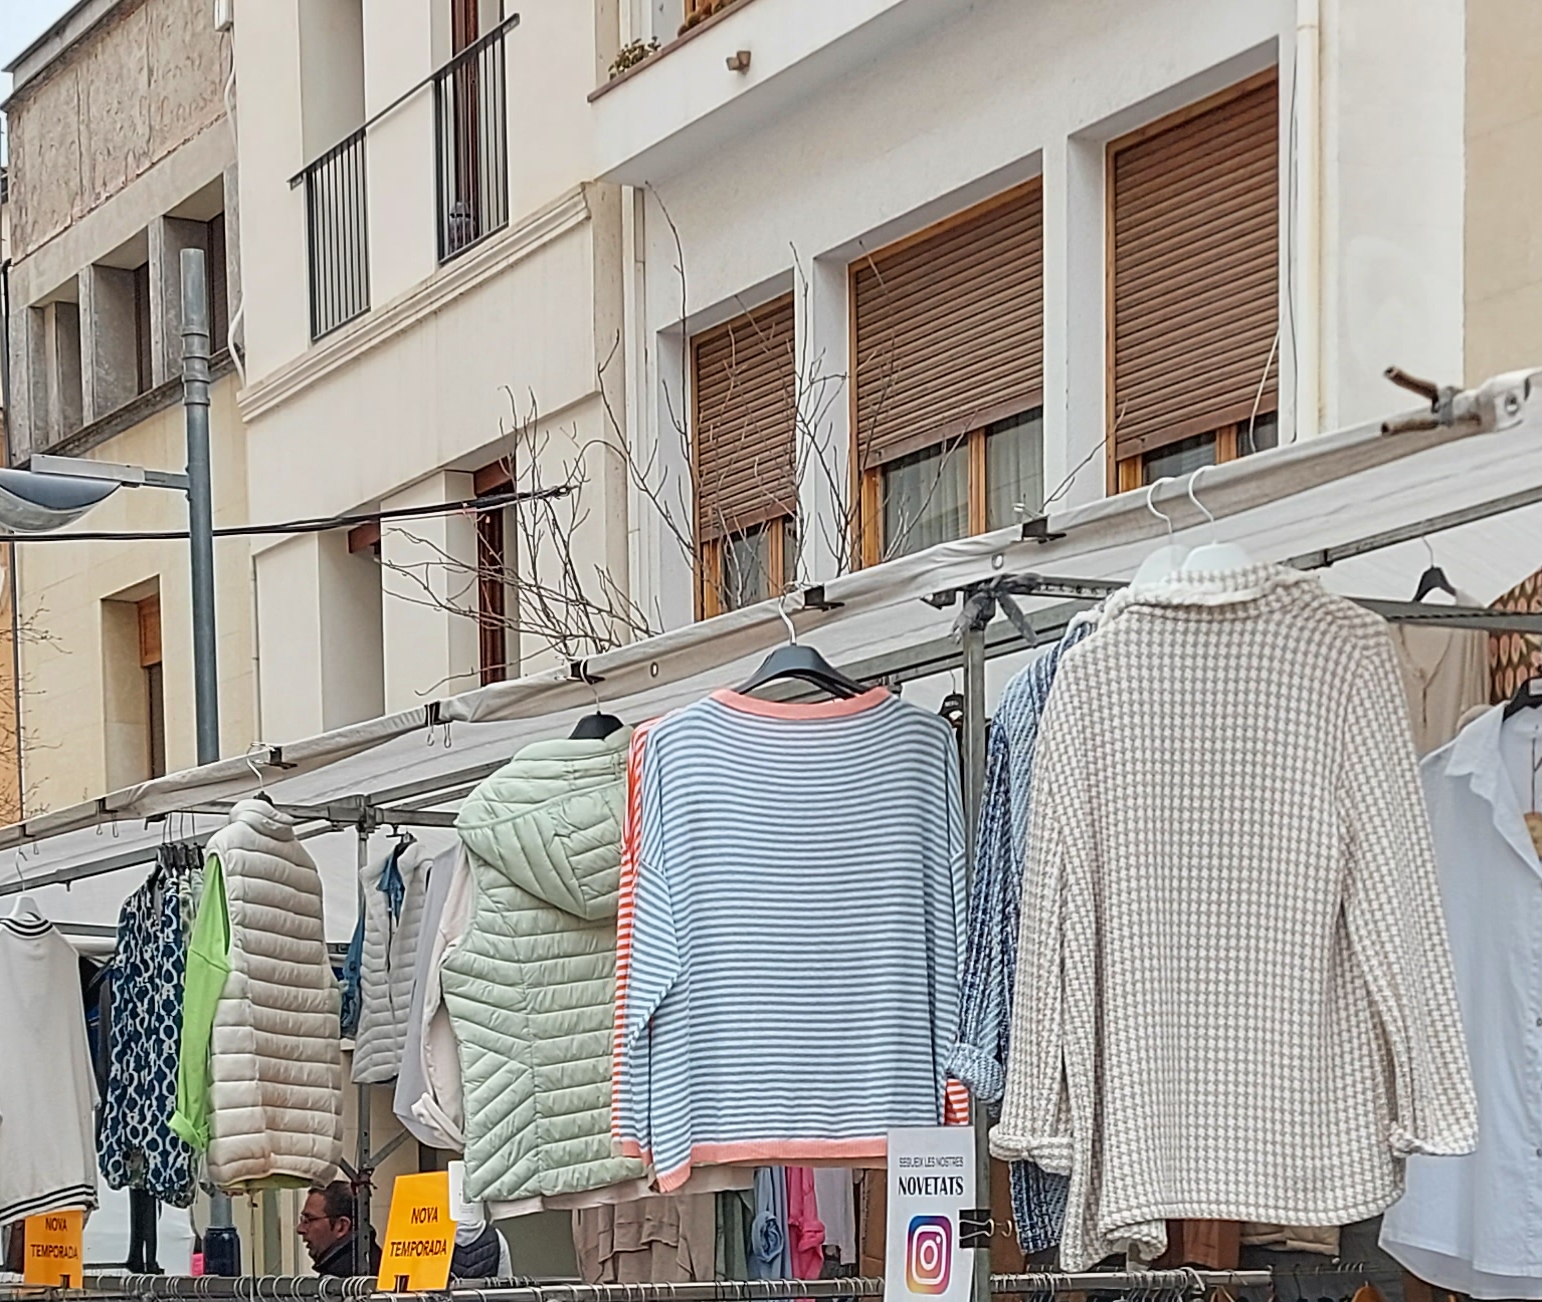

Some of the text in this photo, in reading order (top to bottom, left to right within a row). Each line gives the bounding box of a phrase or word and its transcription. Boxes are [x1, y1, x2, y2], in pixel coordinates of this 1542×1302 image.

[898, 1176, 964, 1196] NOVETATS
[411, 1206, 438, 1224] NOVA
[45, 1217, 67, 1232] NOVA
[30, 1244, 78, 1260] TEMPORADA
[390, 1239, 447, 1257] TEMPORADA
